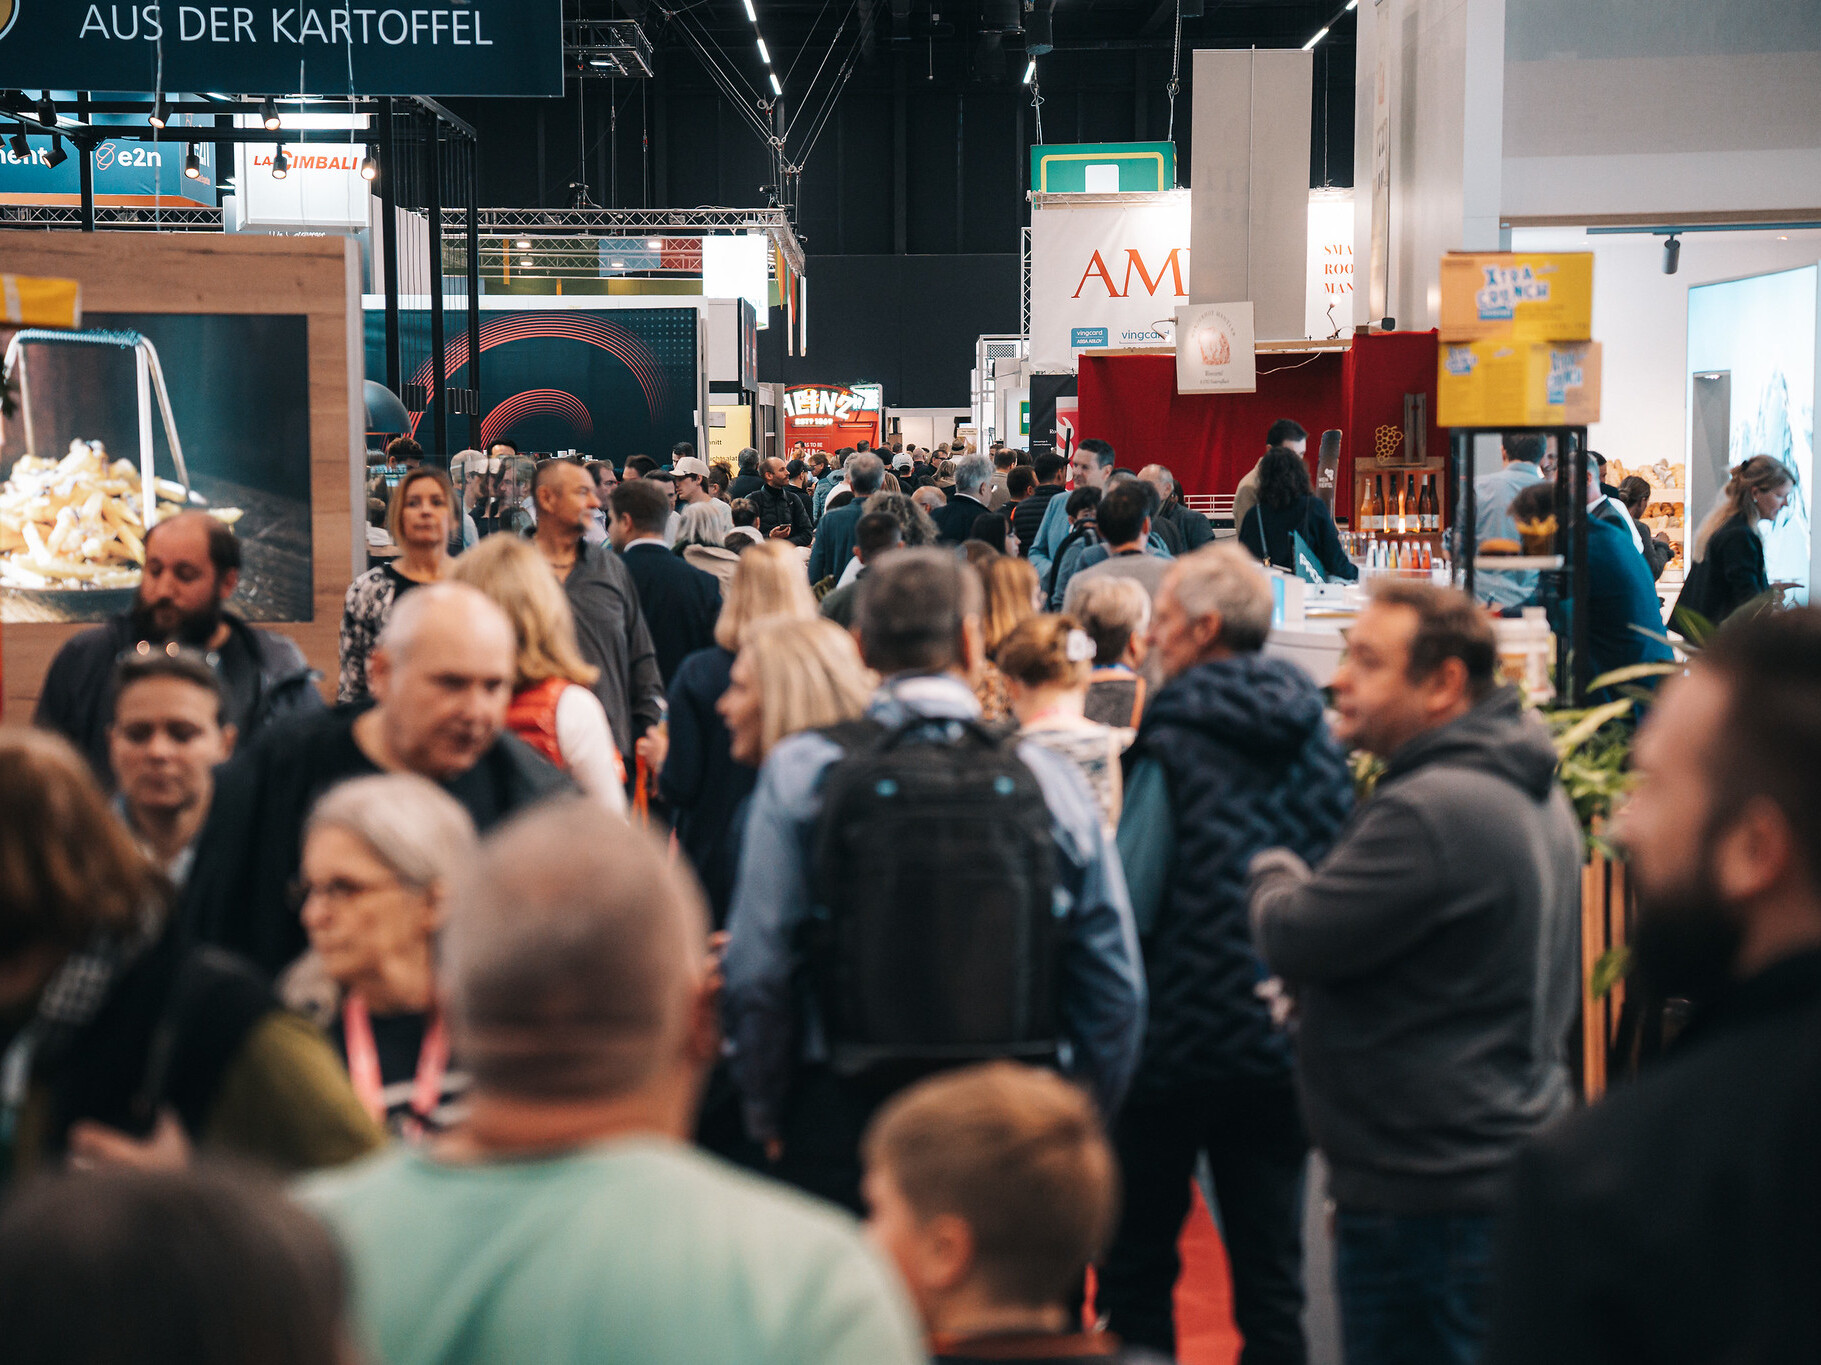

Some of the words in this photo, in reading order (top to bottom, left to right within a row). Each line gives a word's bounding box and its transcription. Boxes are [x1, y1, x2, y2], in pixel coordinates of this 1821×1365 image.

[79, 4, 163, 41] AUS
[178, 6, 257, 43] DER
[272, 8, 494, 46] KARTOFFEL
[117, 147, 162, 168] e2n
[253, 155, 274, 166] LA
[274, 150, 358, 170] CIMBALI
[1070, 248, 1191, 298] AM
[1076, 329, 1103, 337] vingcard
